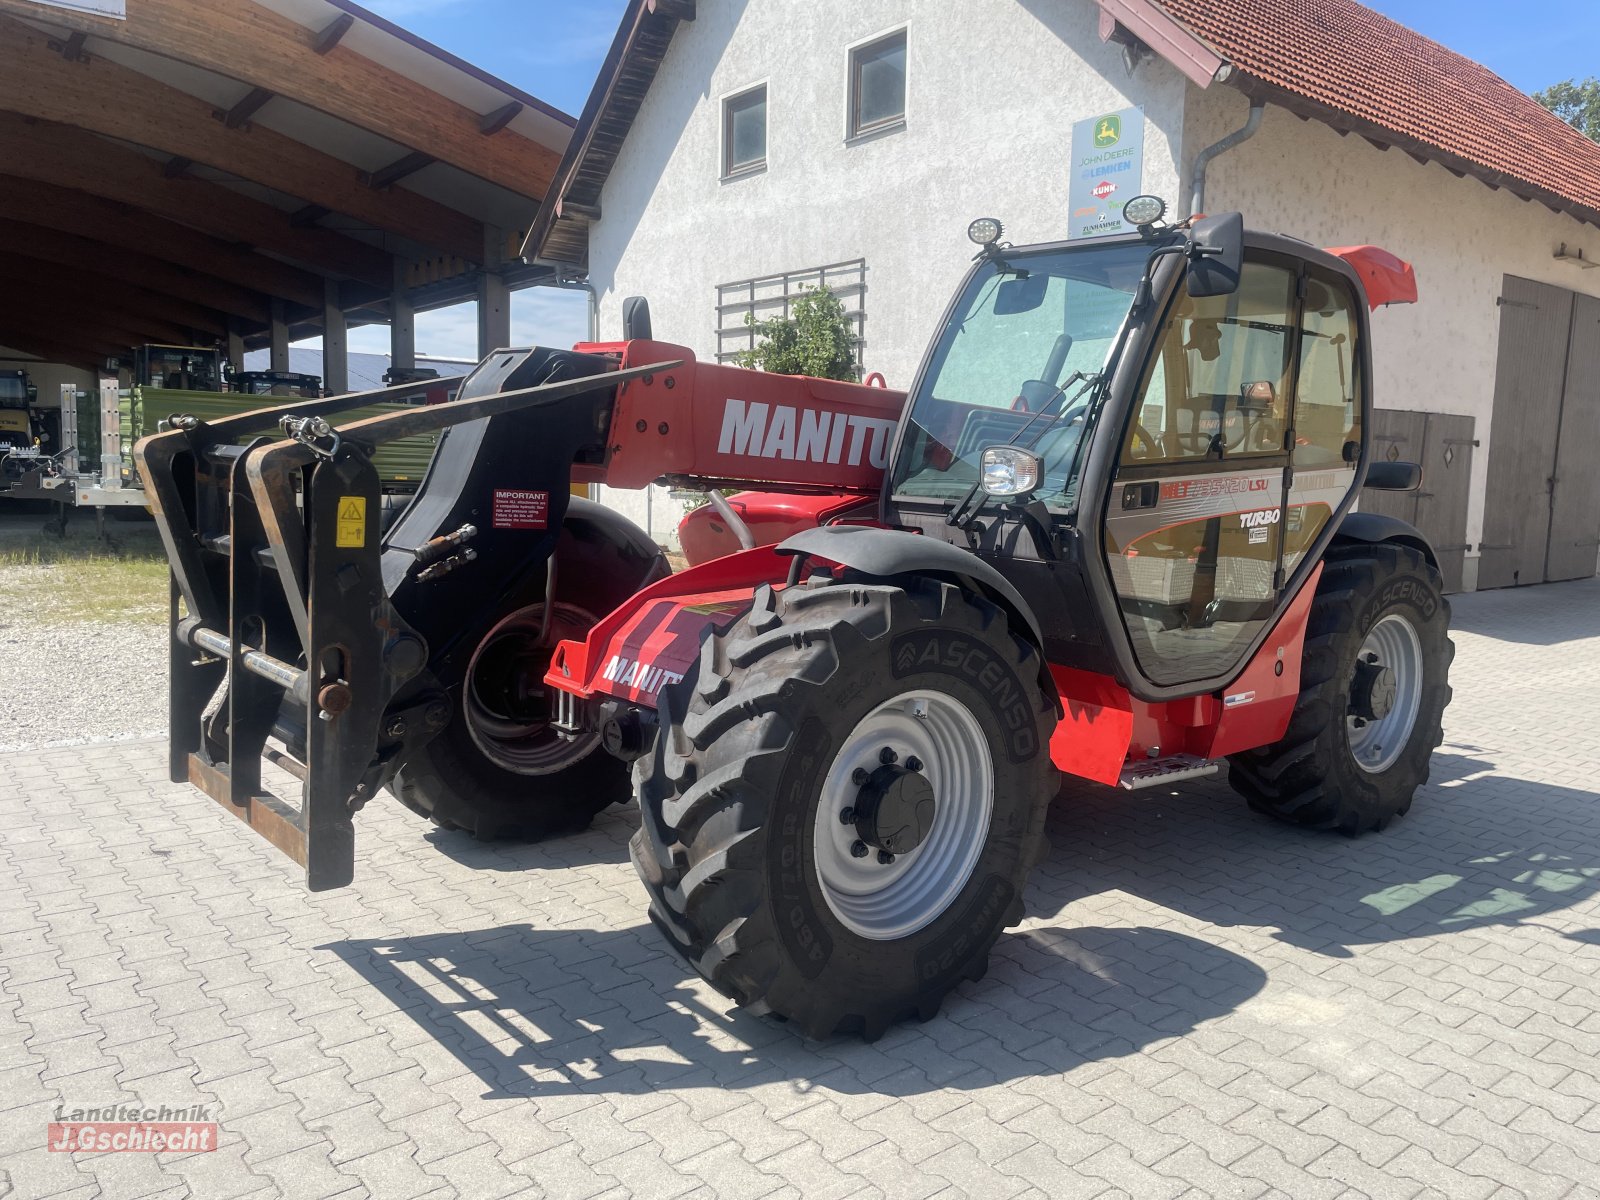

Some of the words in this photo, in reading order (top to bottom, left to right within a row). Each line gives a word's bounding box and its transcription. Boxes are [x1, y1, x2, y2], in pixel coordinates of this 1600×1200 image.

[1080, 155, 1103, 167] JOHN
[1104, 148, 1134, 161] DEERE
[1091, 161, 1131, 177] LEMKEN
[1093, 184, 1116, 195] KUHN
[1083, 220, 1121, 231] ZUNHAMMER
[717, 398, 899, 470] MANITO
[1249, 480, 1269, 491] LSU
[496, 491, 546, 500] IMPORTANT
[1240, 509, 1280, 528] TURBO
[1371, 580, 1435, 620] ASCENSO
[602, 655, 684, 696] MANIT
[916, 638, 1034, 756] ASCENSO
